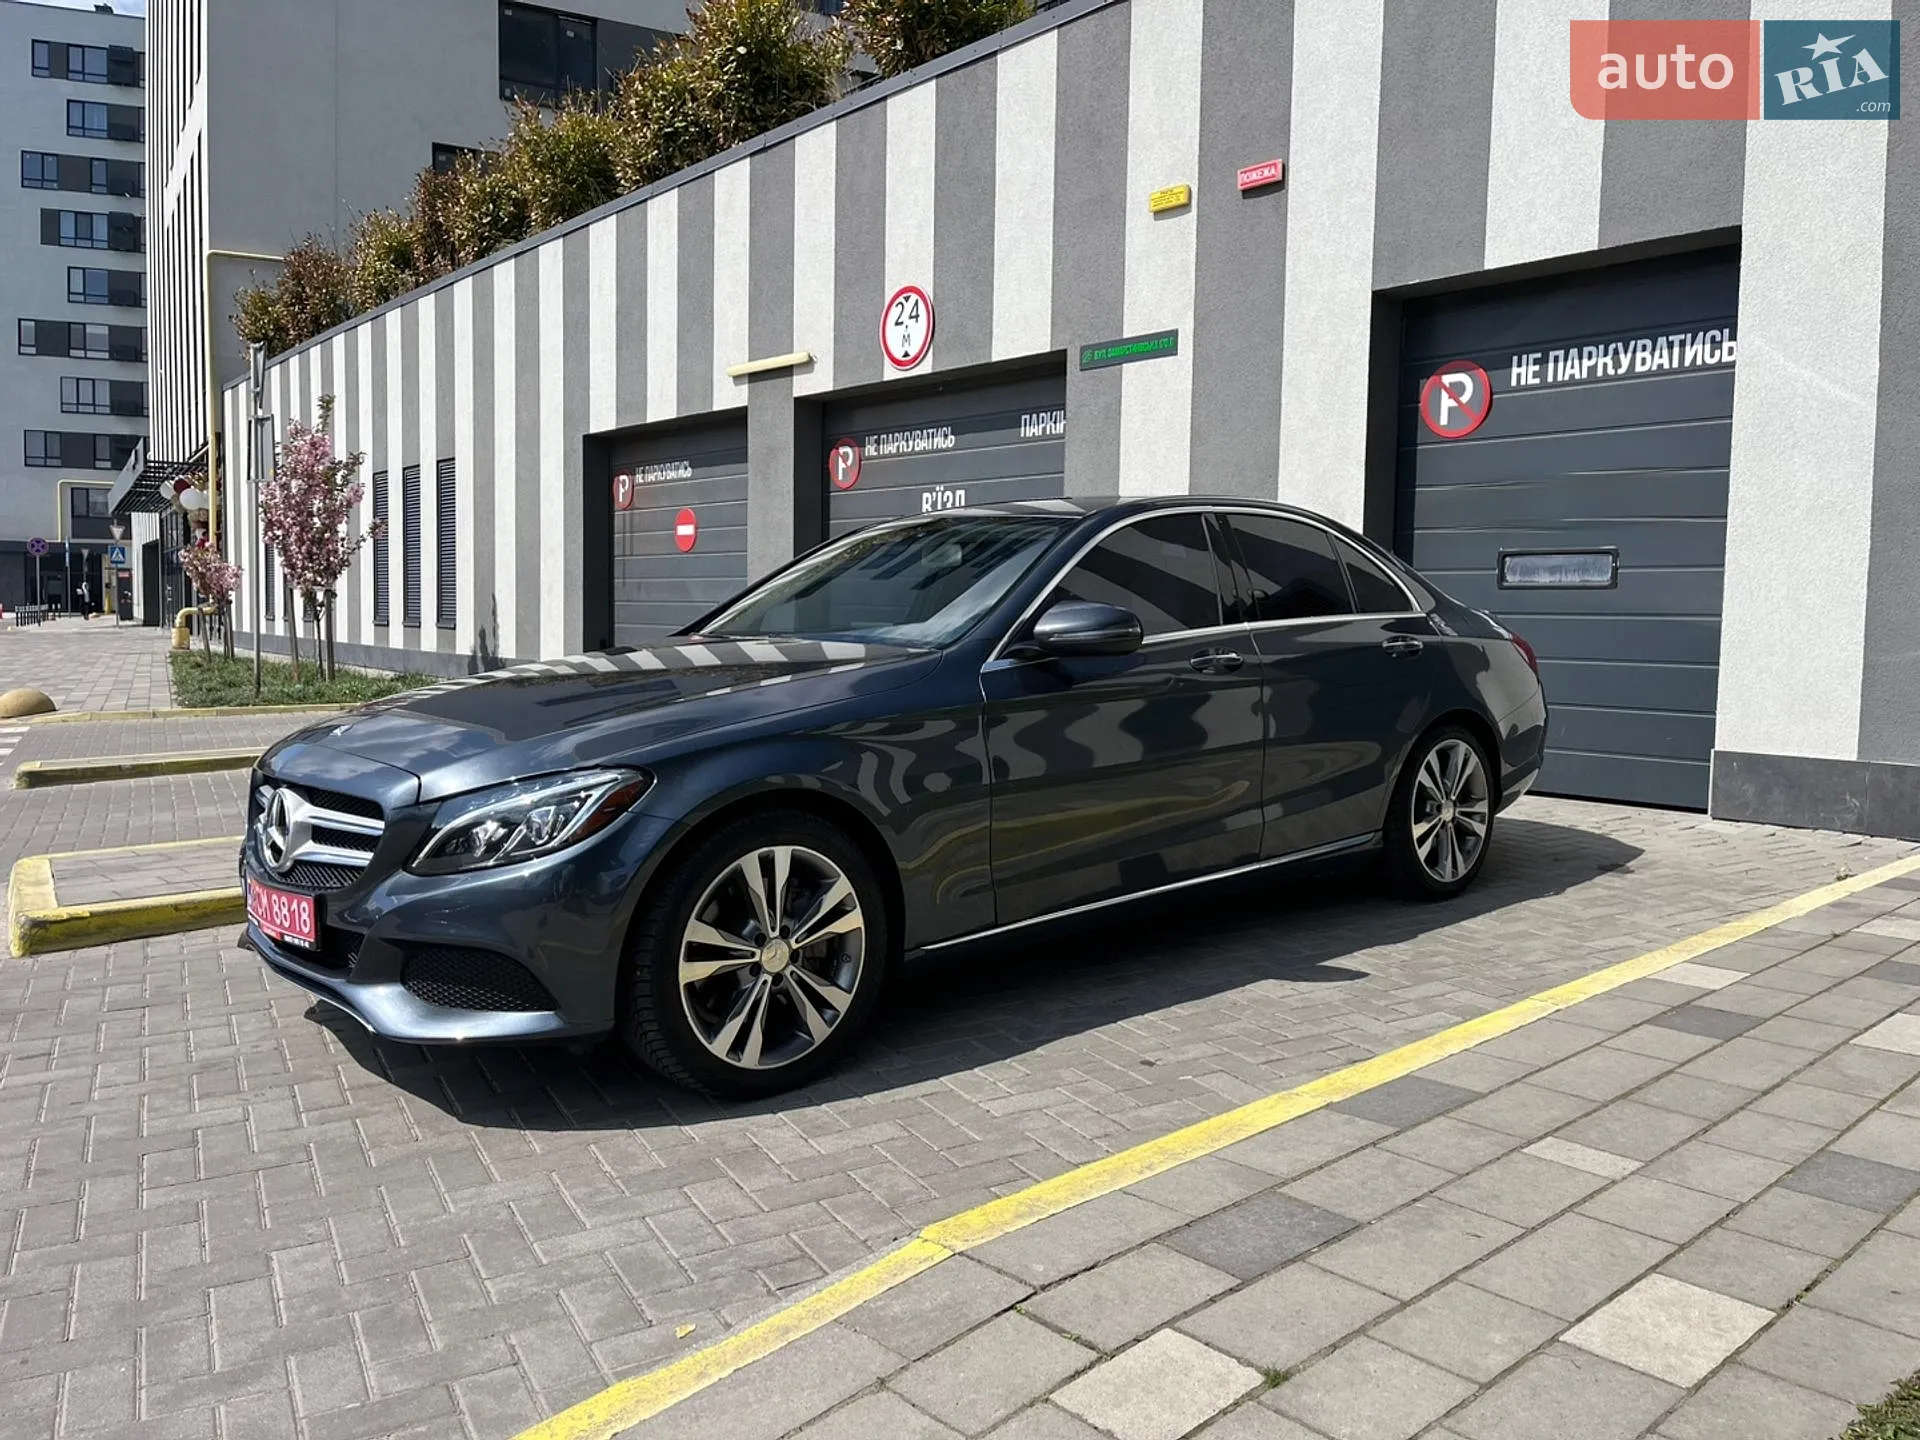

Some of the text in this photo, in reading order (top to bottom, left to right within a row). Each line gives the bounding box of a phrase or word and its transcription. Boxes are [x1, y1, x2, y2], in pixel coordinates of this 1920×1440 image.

[1510, 328, 1737, 387] НЕ ПАРКУВАТИСЬ
[865, 427, 956, 457] НЕ ПАРКУВАТИСЬ
[271, 893, 311, 934] 8818
